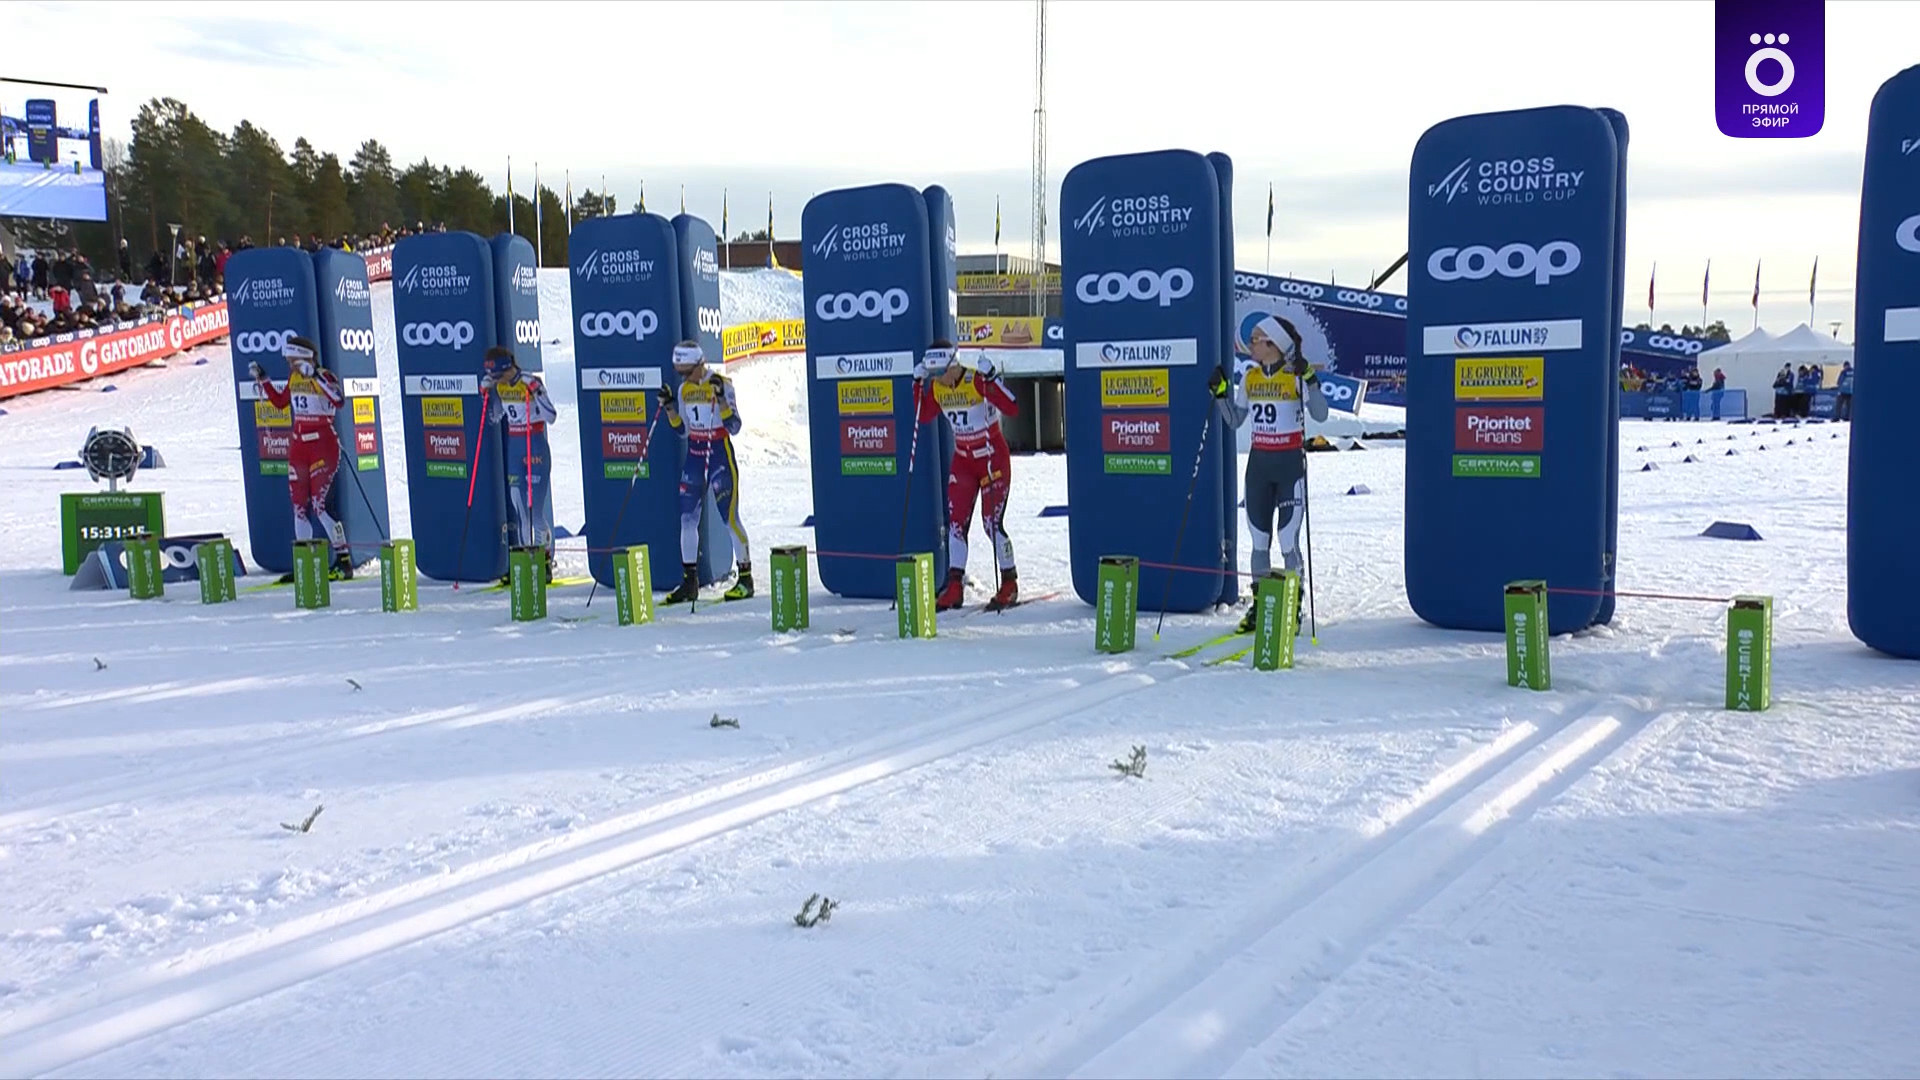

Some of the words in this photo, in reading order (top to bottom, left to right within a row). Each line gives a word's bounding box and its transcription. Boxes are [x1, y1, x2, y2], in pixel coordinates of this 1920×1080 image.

[1478, 156, 1555, 177] CROSS
[1478, 171, 1585, 193] COUNTRY
[1112, 194, 1170, 213] CROSS
[1478, 191, 1534, 206] WORLD
[1543, 189, 1576, 202] CUP
[1112, 207, 1193, 227] COUNTRY
[842, 223, 888, 239] CROSS
[1112, 226, 1156, 238] WORLD
[1162, 223, 1188, 234] CUP
[843, 233, 906, 252] COUNTRY
[601, 250, 640, 263] CROSS
[843, 250, 878, 262] WORLD
[883, 248, 903, 257] CUP
[602, 261, 654, 275] COUNTRY
[1427, 241, 1581, 285] coop
[421, 265, 457, 277] CROSS
[252, 278, 282, 290] CROSS
[345, 279, 362, 290] CROSS
[422, 276, 471, 288] COUNTRY
[602, 275, 631, 284] WORLD
[1076, 268, 1194, 306] coop
[252, 287, 295, 300] COUNTRY
[423, 288, 449, 296] WORLD
[453, 287, 468, 295] CUP
[1280, 281, 1324, 299] coop
[1337, 290, 1382, 308] coop
[815, 288, 910, 323] coop
[580, 309, 658, 341] coop
[699, 306, 721, 339] coop
[32, 337, 50, 348] coop
[56, 333, 74, 343] coop
[118, 321, 134, 331] coop
[403, 321, 474, 350] coop
[515, 320, 541, 348] coop
[783, 324, 793, 338] LE
[1484, 328, 1532, 346] FALUN
[0, 351, 75, 385] ATORADE
[80, 341, 98, 374] G
[100, 328, 166, 364] GATORADE
[182, 310, 229, 339] GATORAD
[340, 328, 374, 356] coop
[1649, 334, 1703, 355] coop
[1123, 346, 1160, 361] FALUN
[1365, 355, 1382, 365] FIS
[854, 358, 883, 372] FALUN
[612, 373, 637, 385] FALUN
[1461, 367, 1474, 379] LE
[433, 379, 456, 390] FALUN
[1106, 377, 1116, 389] LE
[841, 388, 850, 398] LE
[1321, 382, 1352, 400] op
[294, 396, 308, 409] 13
[508, 404, 518, 418] 6
[692, 405, 699, 421] 1
[948, 411, 968, 426] 27
[1252, 403, 1277, 424] 29
[1112, 421, 1160, 435] Prioritet
[1468, 415, 1532, 431] Prioritet
[608, 432, 642, 444] Prioritet
[848, 426, 888, 440] Prioritet
[1118, 433, 1154, 445] Finans
[1476, 430, 1522, 444] Finans
[430, 435, 460, 447] Prioritet
[613, 443, 638, 453] Finans
[853, 438, 883, 449] Finans
[434, 446, 457, 455] Finans
[844, 461, 883, 469] CERTINA
[1108, 458, 1156, 466] CERTINA
[1458, 459, 1520, 468] CERTINA
[81, 525, 146, 539] 15:31:15
[636, 566, 648, 620] CERTINA
[921, 575, 932, 636] CERTINA
[1102, 595, 1113, 646] CERTINA
[1262, 609, 1275, 665] CERTINA
[1283, 597, 1295, 665] CERTINA
[1514, 628, 1528, 689] CERTINA
[1737, 646, 1751, 710] CERTINA
